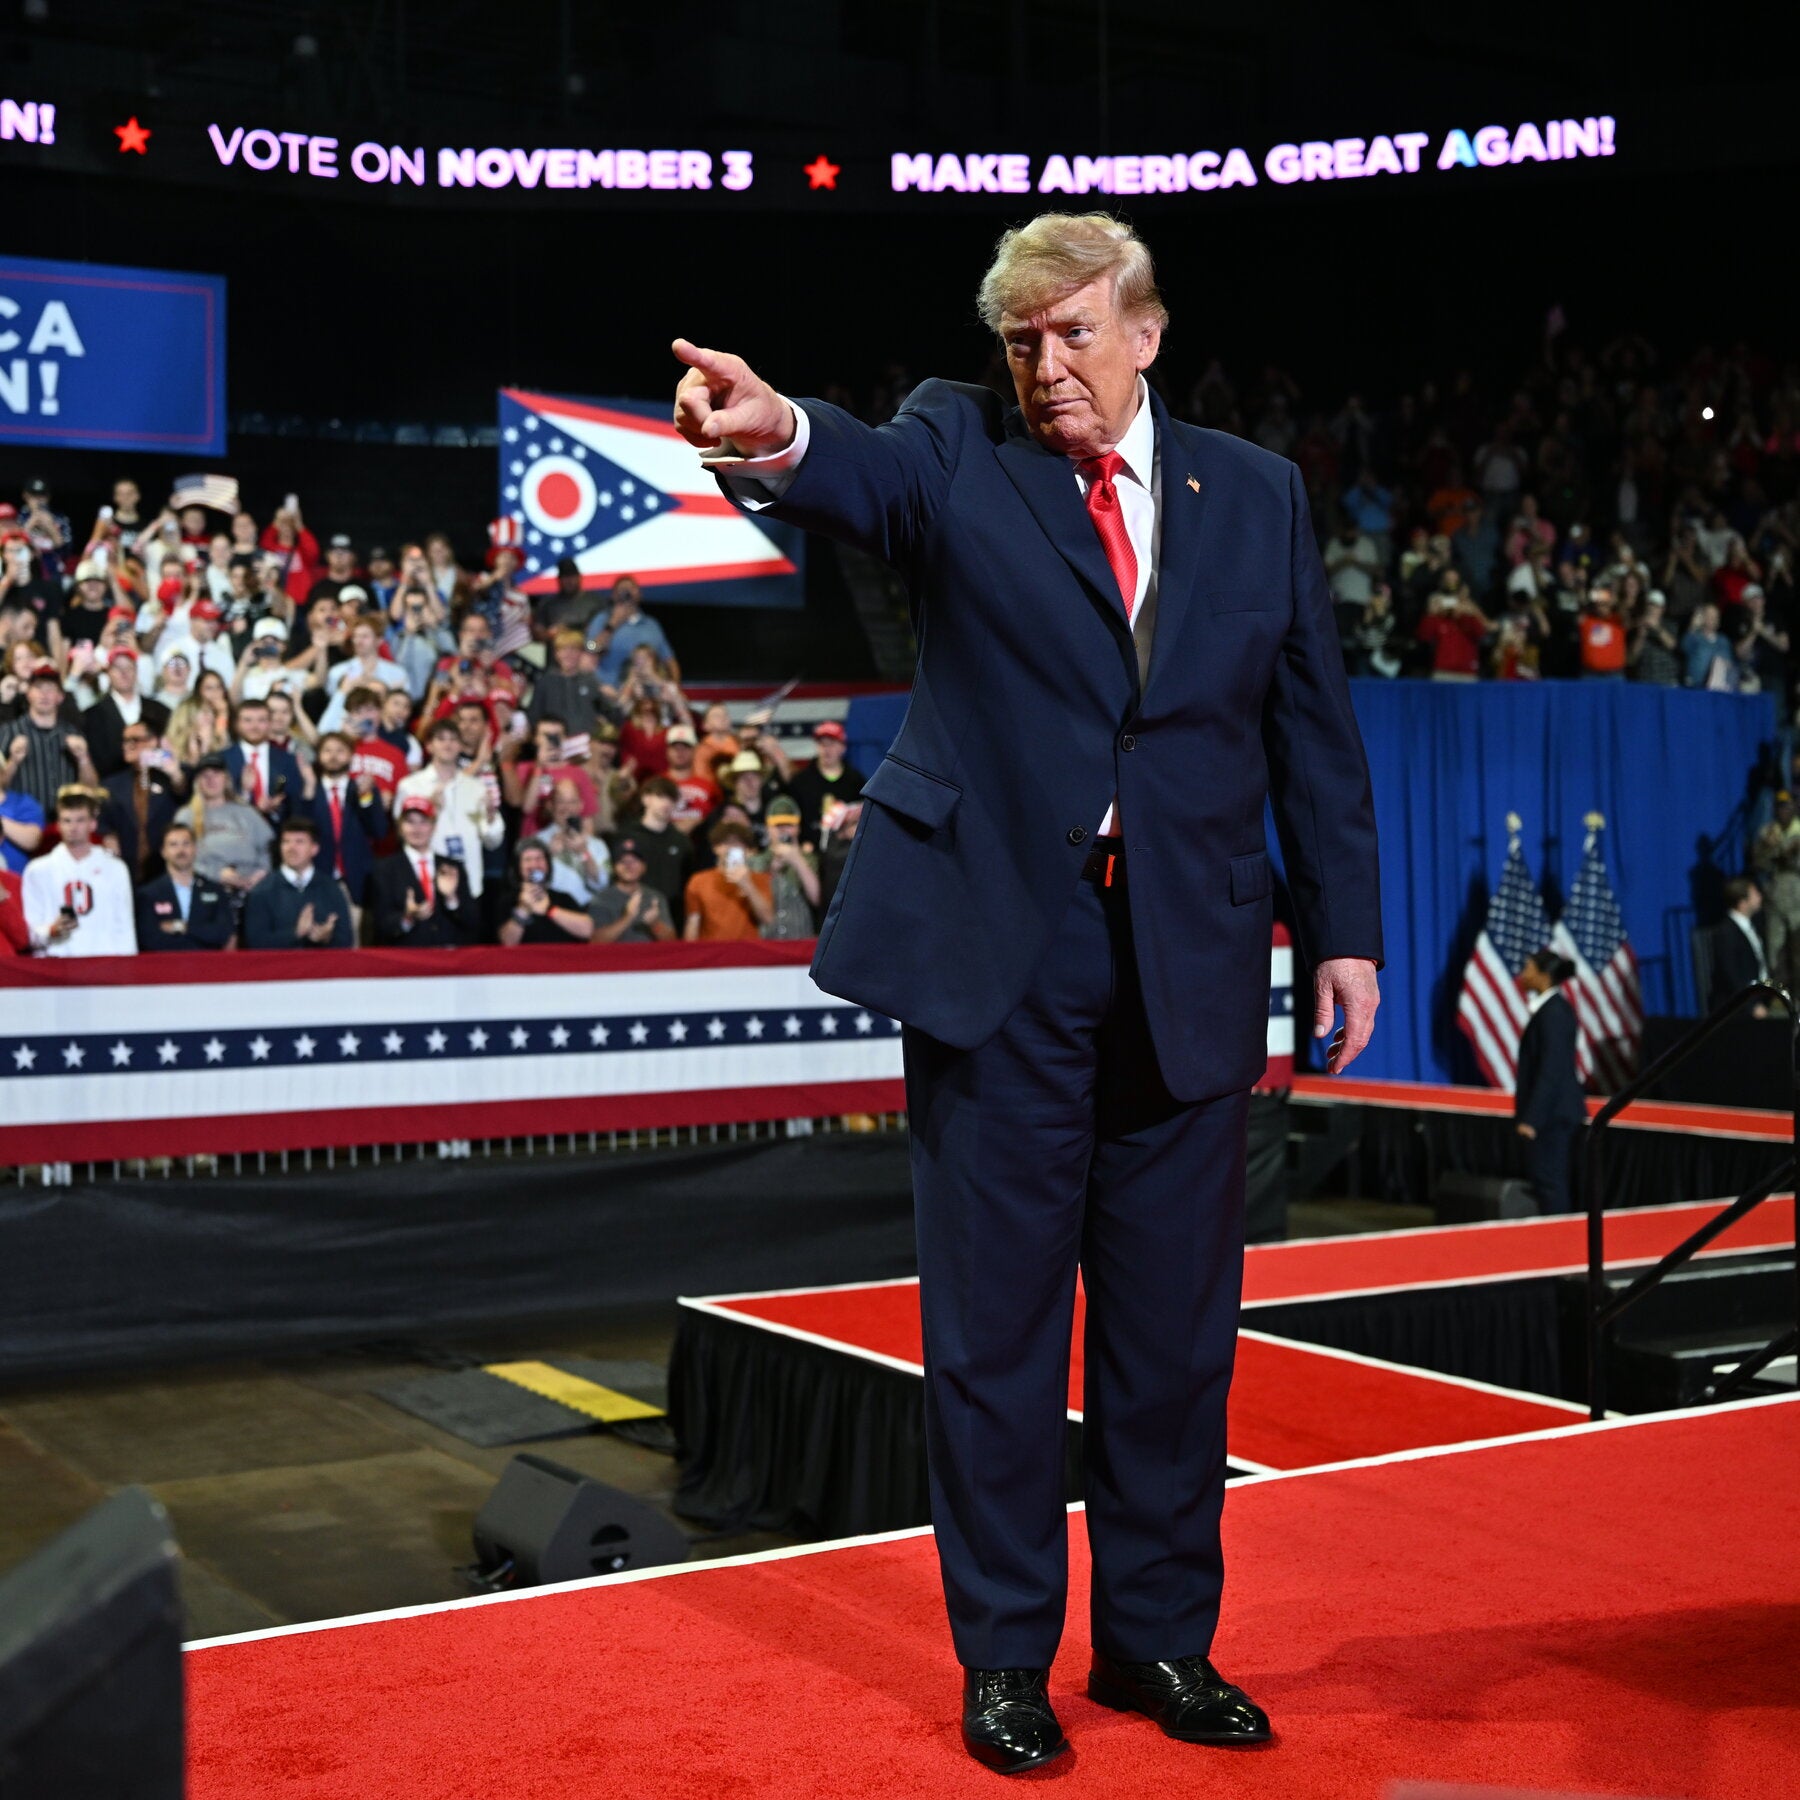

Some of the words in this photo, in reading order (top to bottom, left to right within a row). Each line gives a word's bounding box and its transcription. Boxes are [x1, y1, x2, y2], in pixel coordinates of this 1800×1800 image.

[0, 99, 56, 145] N!
[891, 152, 1031, 194] MAKE
[1038, 149, 1258, 196] AMERICA
[1265, 133, 1430, 186] GREAT
[1437, 115, 1617, 172] AGAIN!
[207, 123, 340, 179] VOTE
[351, 143, 426, 187] ON
[437, 147, 714, 191] NOVEMBER
[721, 150, 755, 192] 3
